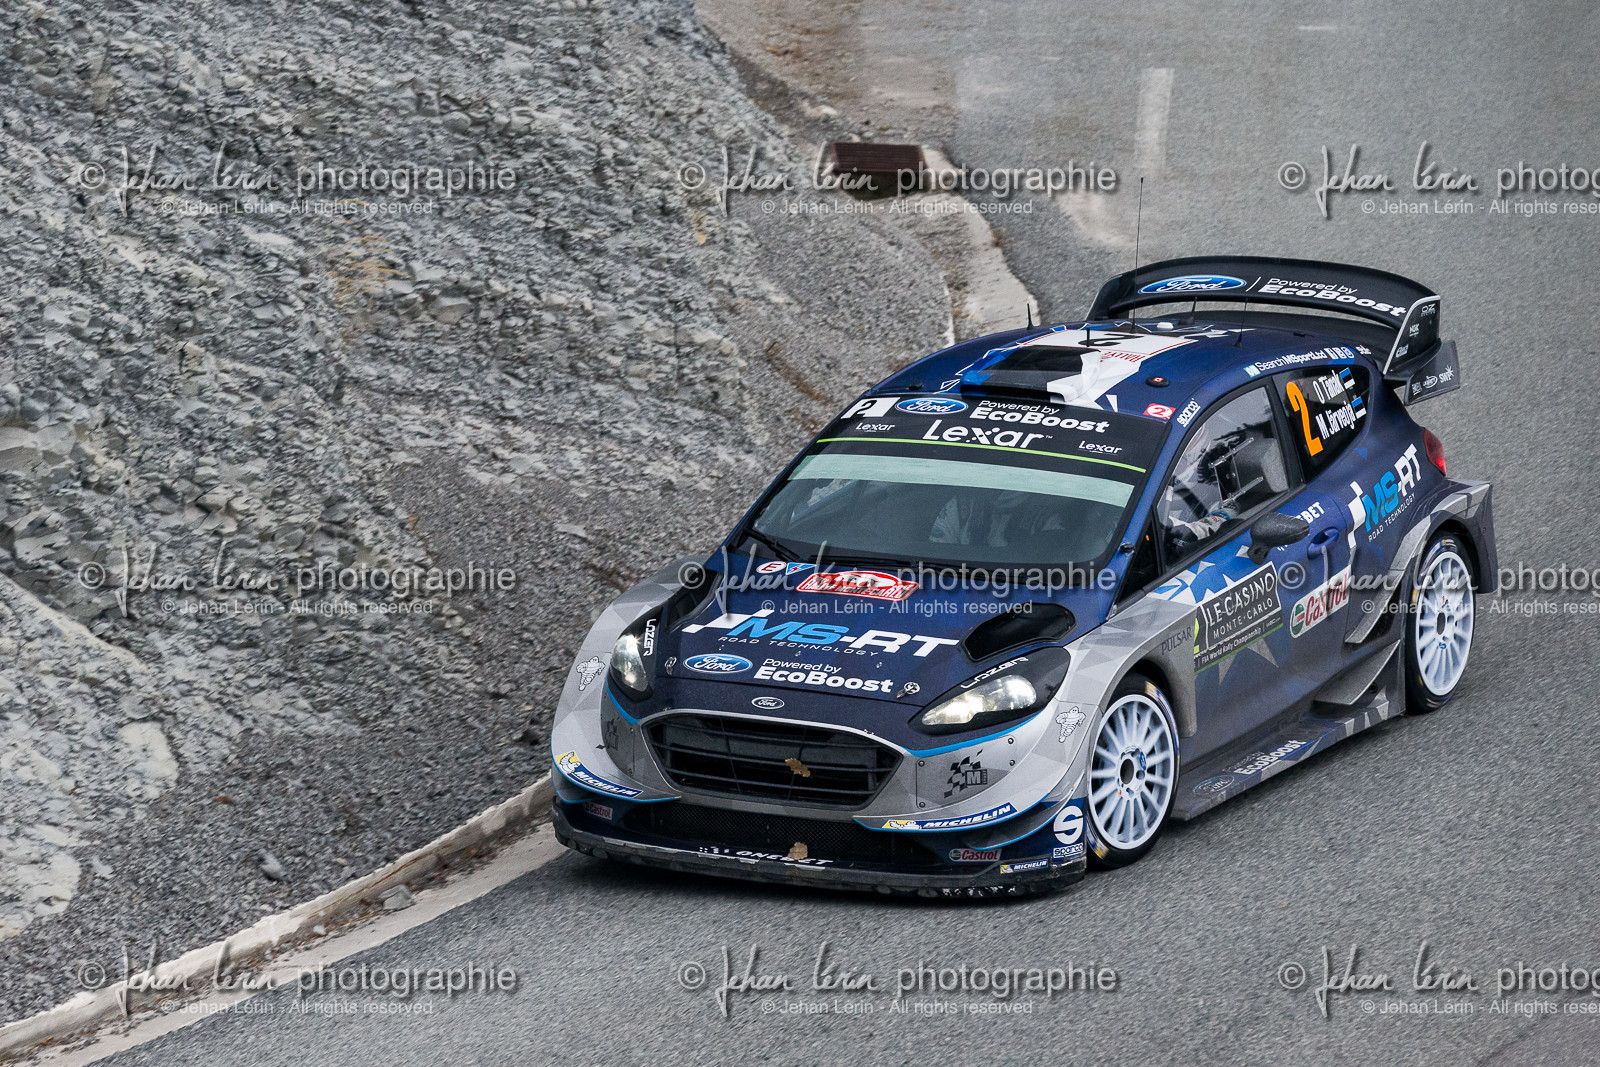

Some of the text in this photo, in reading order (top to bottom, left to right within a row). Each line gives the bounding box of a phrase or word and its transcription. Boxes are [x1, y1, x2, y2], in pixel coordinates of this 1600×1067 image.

[1157, 276, 1222, 291] Ford
[1267, 277, 1358, 295] Powered by
[1258, 285, 1407, 317] EcoBoost
[1313, 380, 1325, 404] O
[851, 399, 878, 418] 2
[906, 399, 956, 412] Ford
[978, 400, 1060, 415] Powered by
[855, 422, 896, 431] Lexar
[969, 406, 1110, 433] EcoBoost
[1286, 382, 1324, 457] 2
[1315, 413, 1330, 440] M
[1078, 440, 1122, 454] Lexar
[1361, 443, 1422, 533] MS-RT
[1368, 492, 1416, 542] ROAD TECHNOLOGY
[1223, 572, 1275, 617] CASINO
[1305, 573, 1347, 626] Castrol
[717, 636, 879, 657] ROAD TECHNOLOGY
[726, 617, 960, 658] MS-RT
[1160, 626, 1193, 656] PULSAR
[696, 655, 741, 673] Ford
[763, 658, 842, 674] Powered by
[753, 666, 894, 693] EcoBoost
[1233, 739, 1307, 775] EcoBoost
[574, 770, 638, 796] MICHELIN
[924, 804, 1011, 828] MICHELIN
[1053, 805, 1084, 845] S
[960, 849, 999, 861] Castrol
[1013, 860, 1048, 871] MICHELIN
